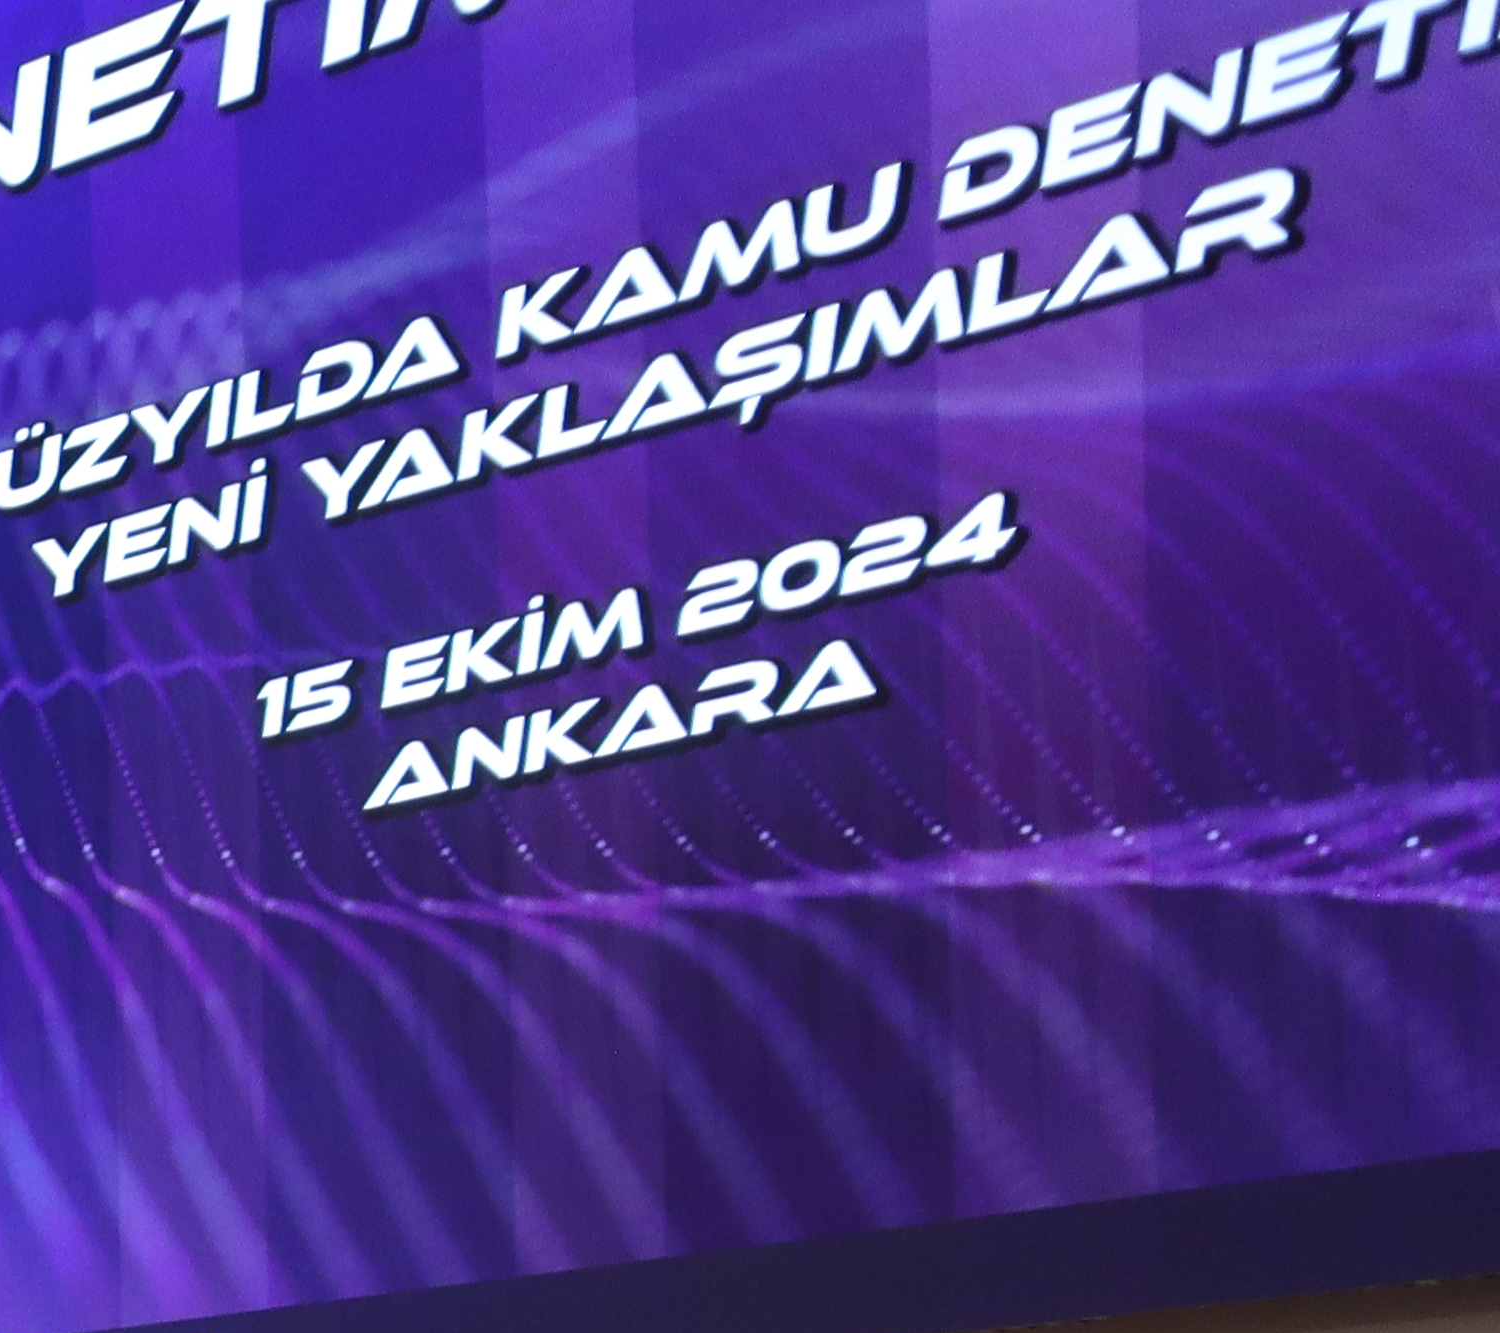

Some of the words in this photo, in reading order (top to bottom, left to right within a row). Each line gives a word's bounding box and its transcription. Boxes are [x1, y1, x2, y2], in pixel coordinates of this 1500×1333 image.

[496, 160, 903, 357] KAMU
[34, 460, 268, 599] YENİ
[304, 166, 1300, 520] YAKLAŞIMLAR
[258, 660, 352, 739] 15
[382, 590, 645, 710] EKİM
[678, 492, 1018, 637] 2024
[365, 639, 878, 811] ANKARA
